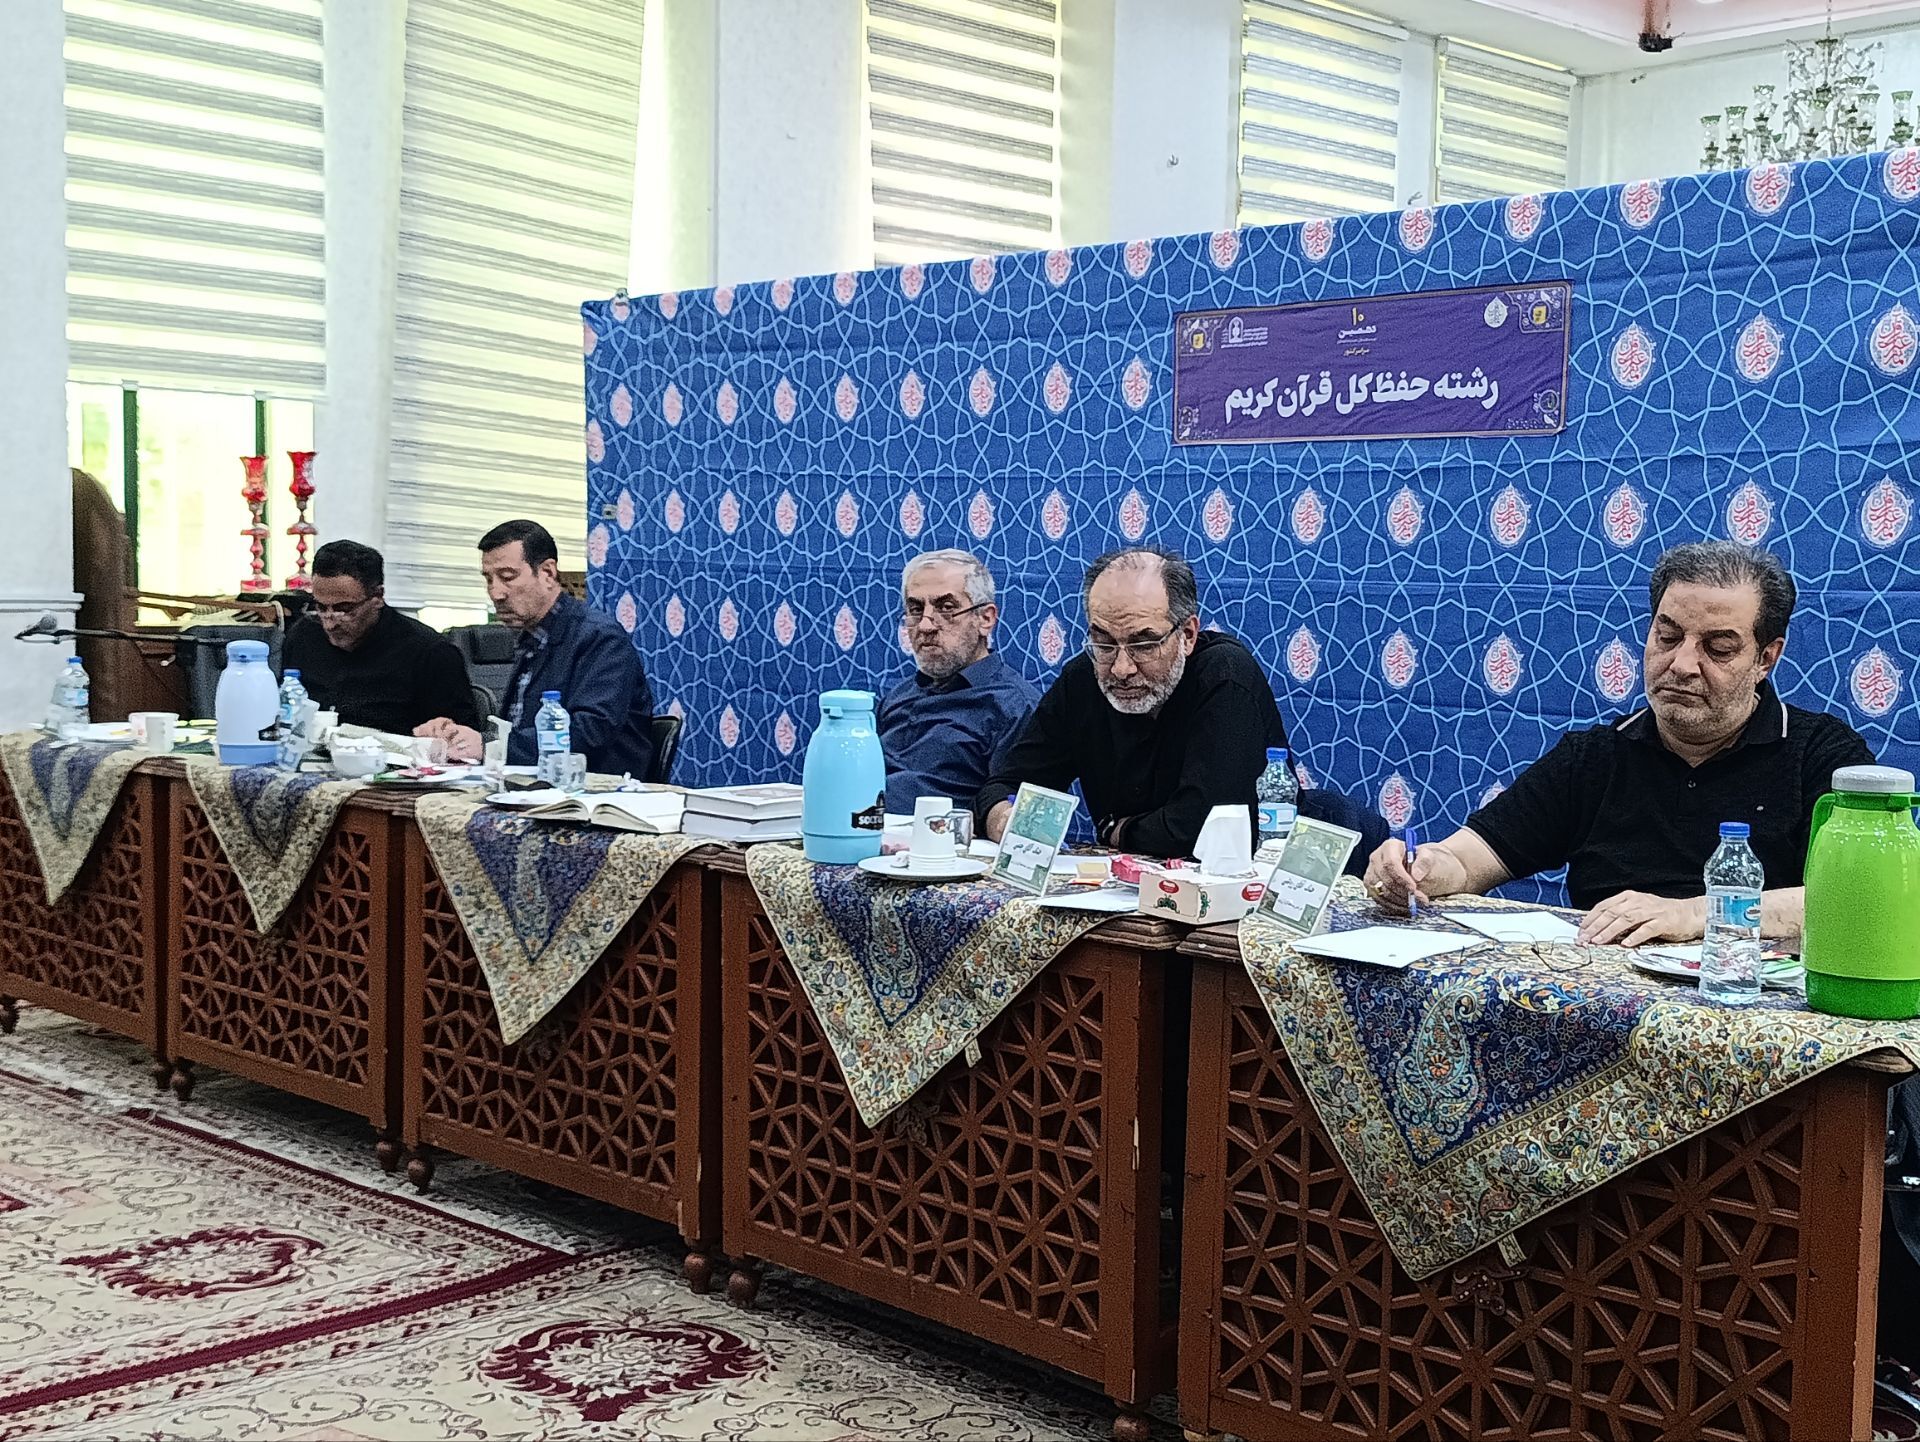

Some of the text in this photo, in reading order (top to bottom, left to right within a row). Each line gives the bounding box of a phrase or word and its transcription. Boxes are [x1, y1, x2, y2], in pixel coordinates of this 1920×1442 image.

[1225, 366, 1499, 424] رشته حفظ کل قرآن کریم
